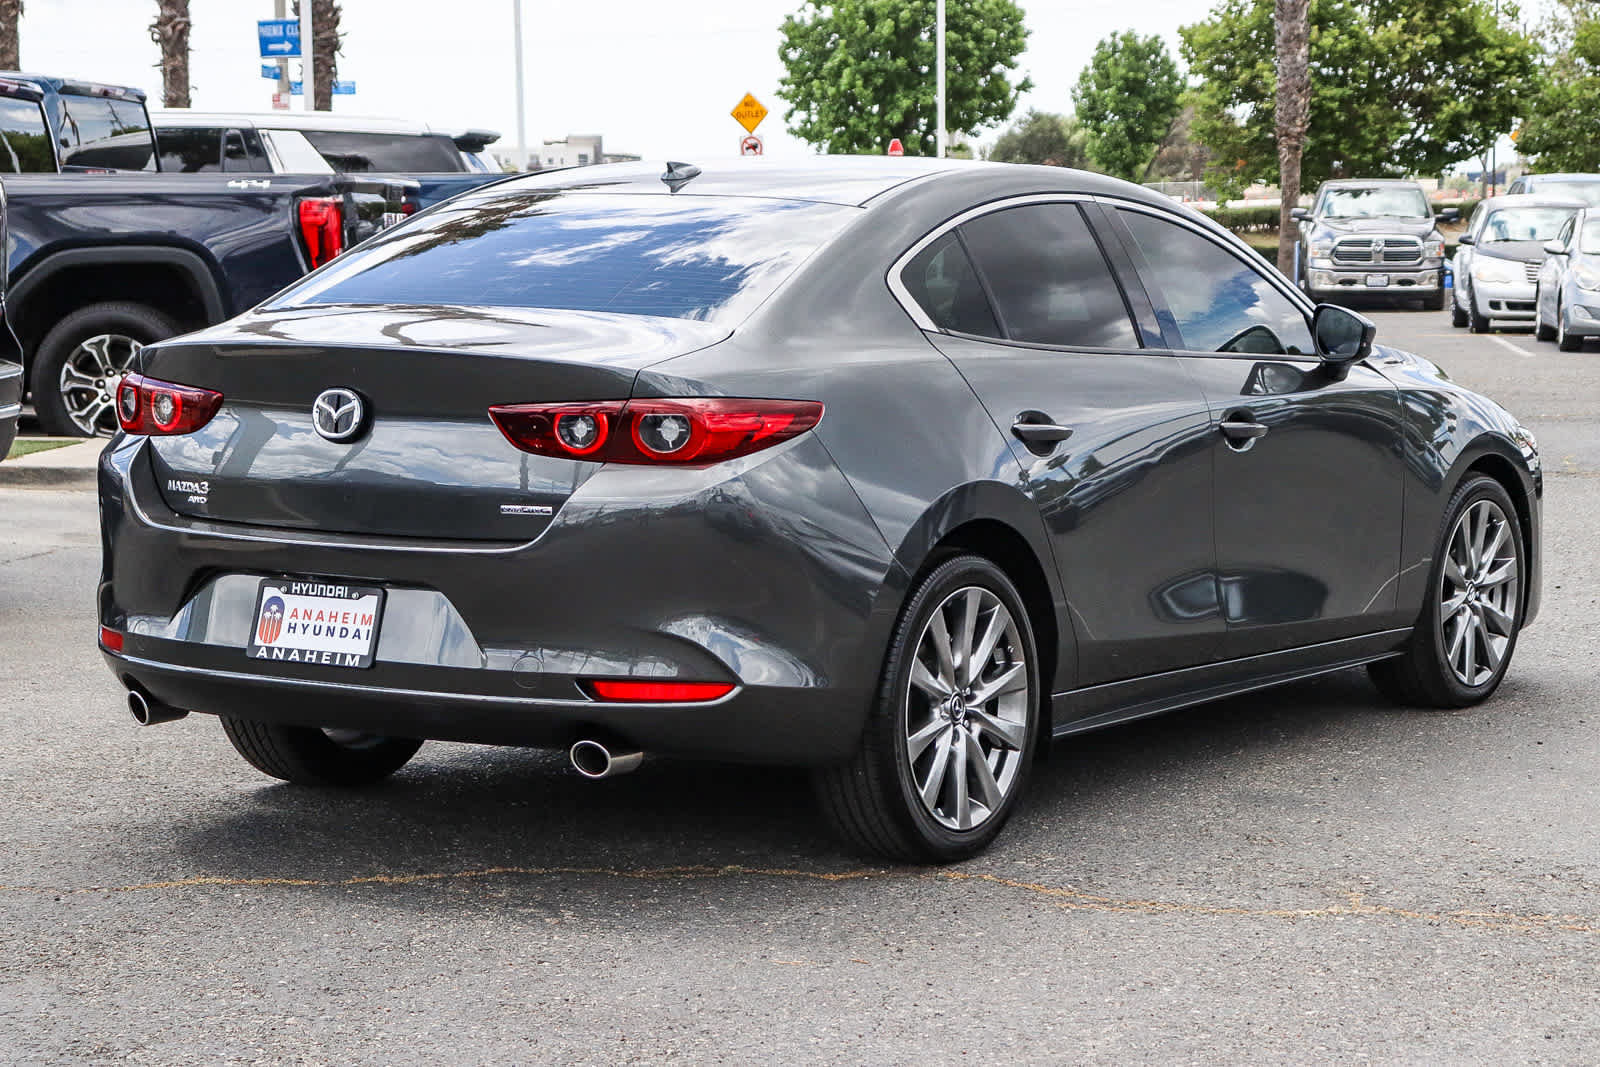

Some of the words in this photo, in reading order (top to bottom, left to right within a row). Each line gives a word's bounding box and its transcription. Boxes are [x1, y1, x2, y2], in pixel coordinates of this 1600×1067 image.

[736, 110, 764, 119] OUTLET
[167, 479, 209, 494] MAZDA3
[292, 582, 348, 598] HYUNDAI
[290, 608, 373, 626] ANAHEIM
[287, 622, 371, 640] HYUNDAI
[255, 646, 361, 667] ANAHEIM
